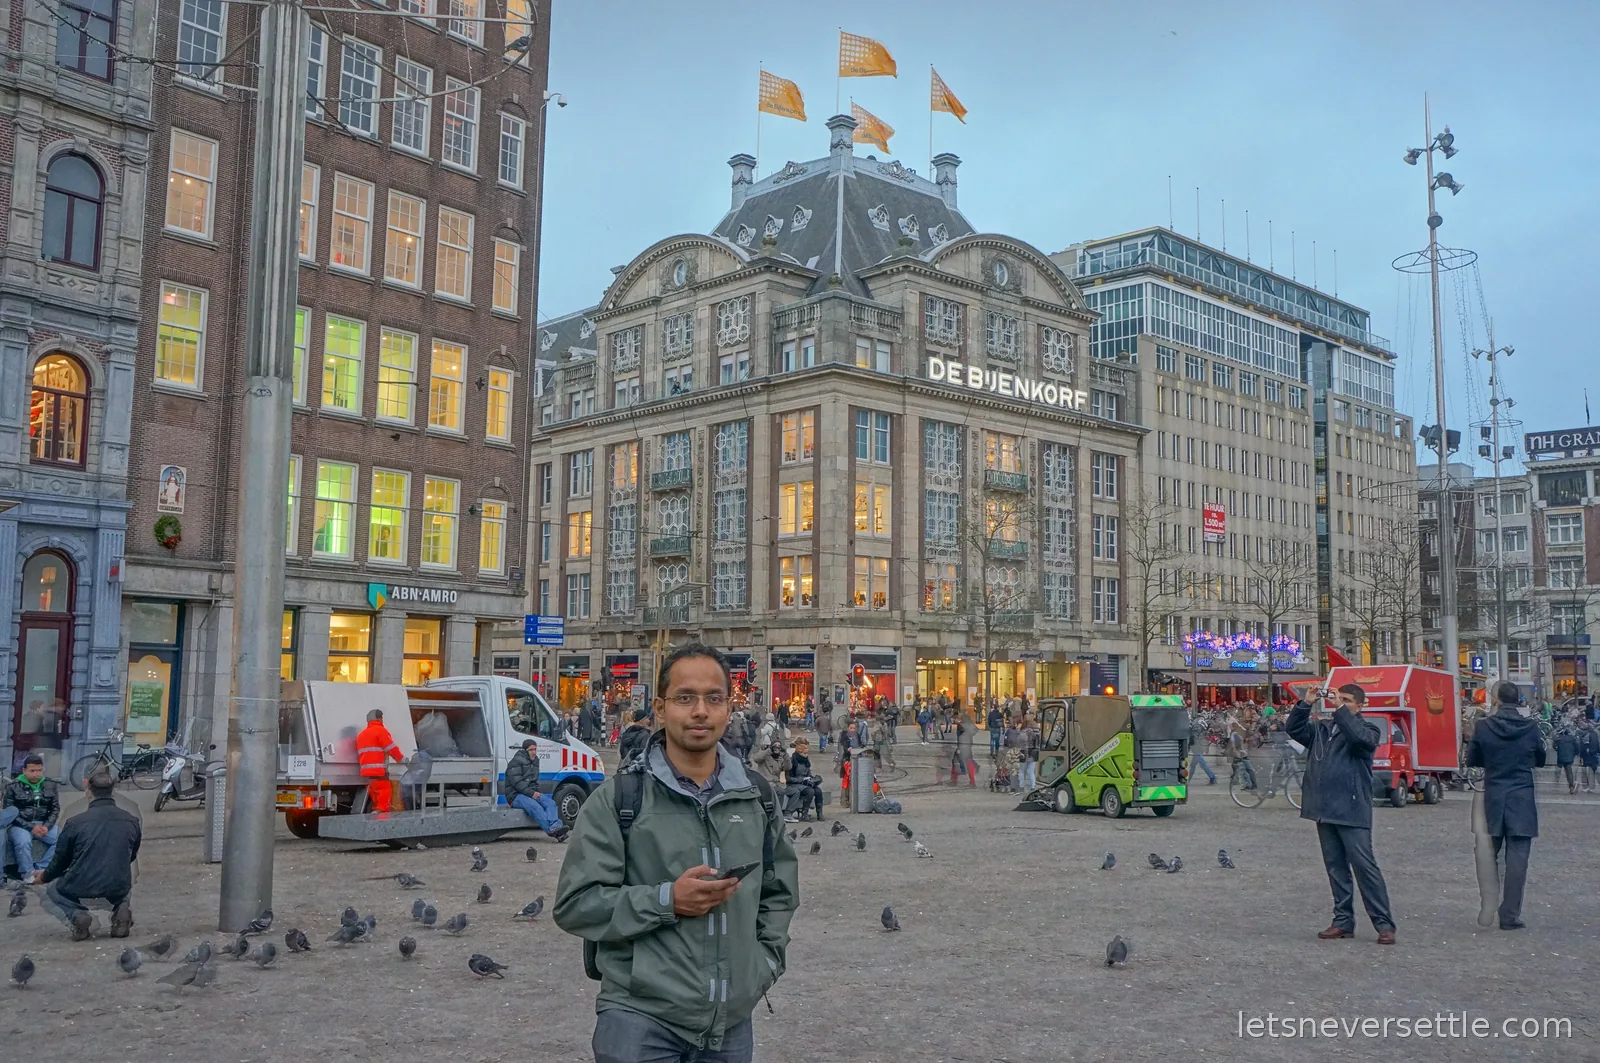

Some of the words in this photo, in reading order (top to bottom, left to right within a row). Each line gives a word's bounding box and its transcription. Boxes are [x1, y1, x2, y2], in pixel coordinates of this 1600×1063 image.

[928, 356, 963, 386] DE
[967, 365, 1088, 411] BIJENKORF
[1204, 502, 1209, 510] TE
[1210, 503, 1225, 513] HUUR
[1185, 654, 1214, 668] Mjestic
[1093, 738, 1119, 761] MACHINES
